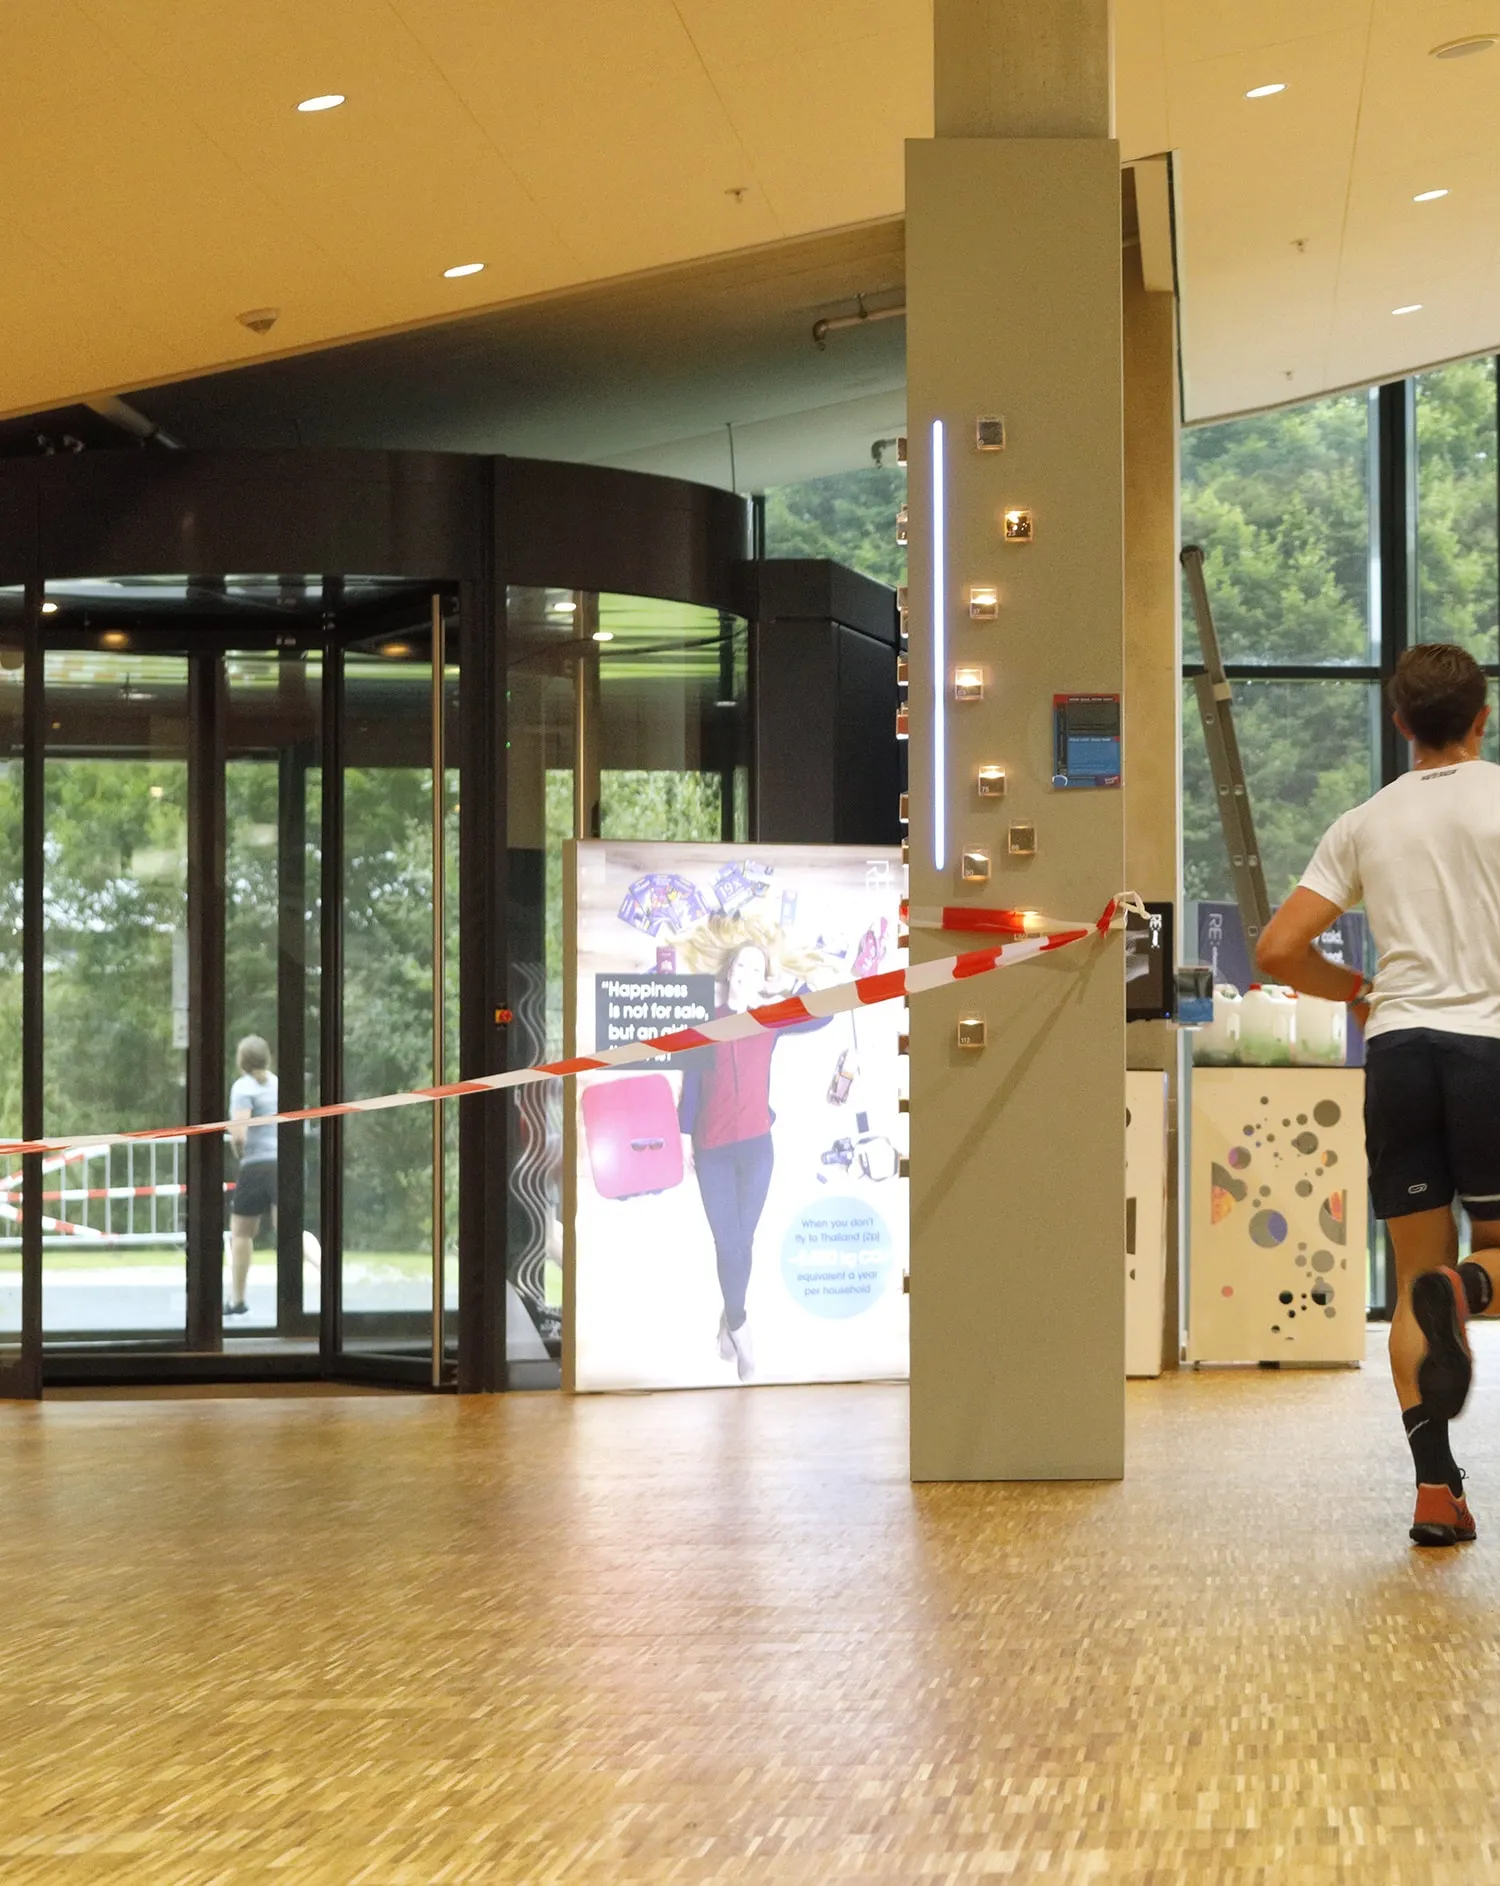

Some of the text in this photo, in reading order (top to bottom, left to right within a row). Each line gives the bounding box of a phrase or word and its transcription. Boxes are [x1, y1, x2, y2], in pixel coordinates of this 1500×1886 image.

[622, 1002, 649, 1019] not
[650, 1002, 672, 1019] for
[674, 1002, 710, 1021] sale,
[608, 1023, 635, 1041] but
[636, 1026, 659, 1041] an
[801, 1217, 874, 1230] When you don't
[795, 1232, 807, 1245] fly
[808, 1233, 819, 1243] to
[820, 1231, 861, 1243] Thailand
[796, 1270, 879, 1283] equivalent a year
[804, 1284, 871, 1297] per household
